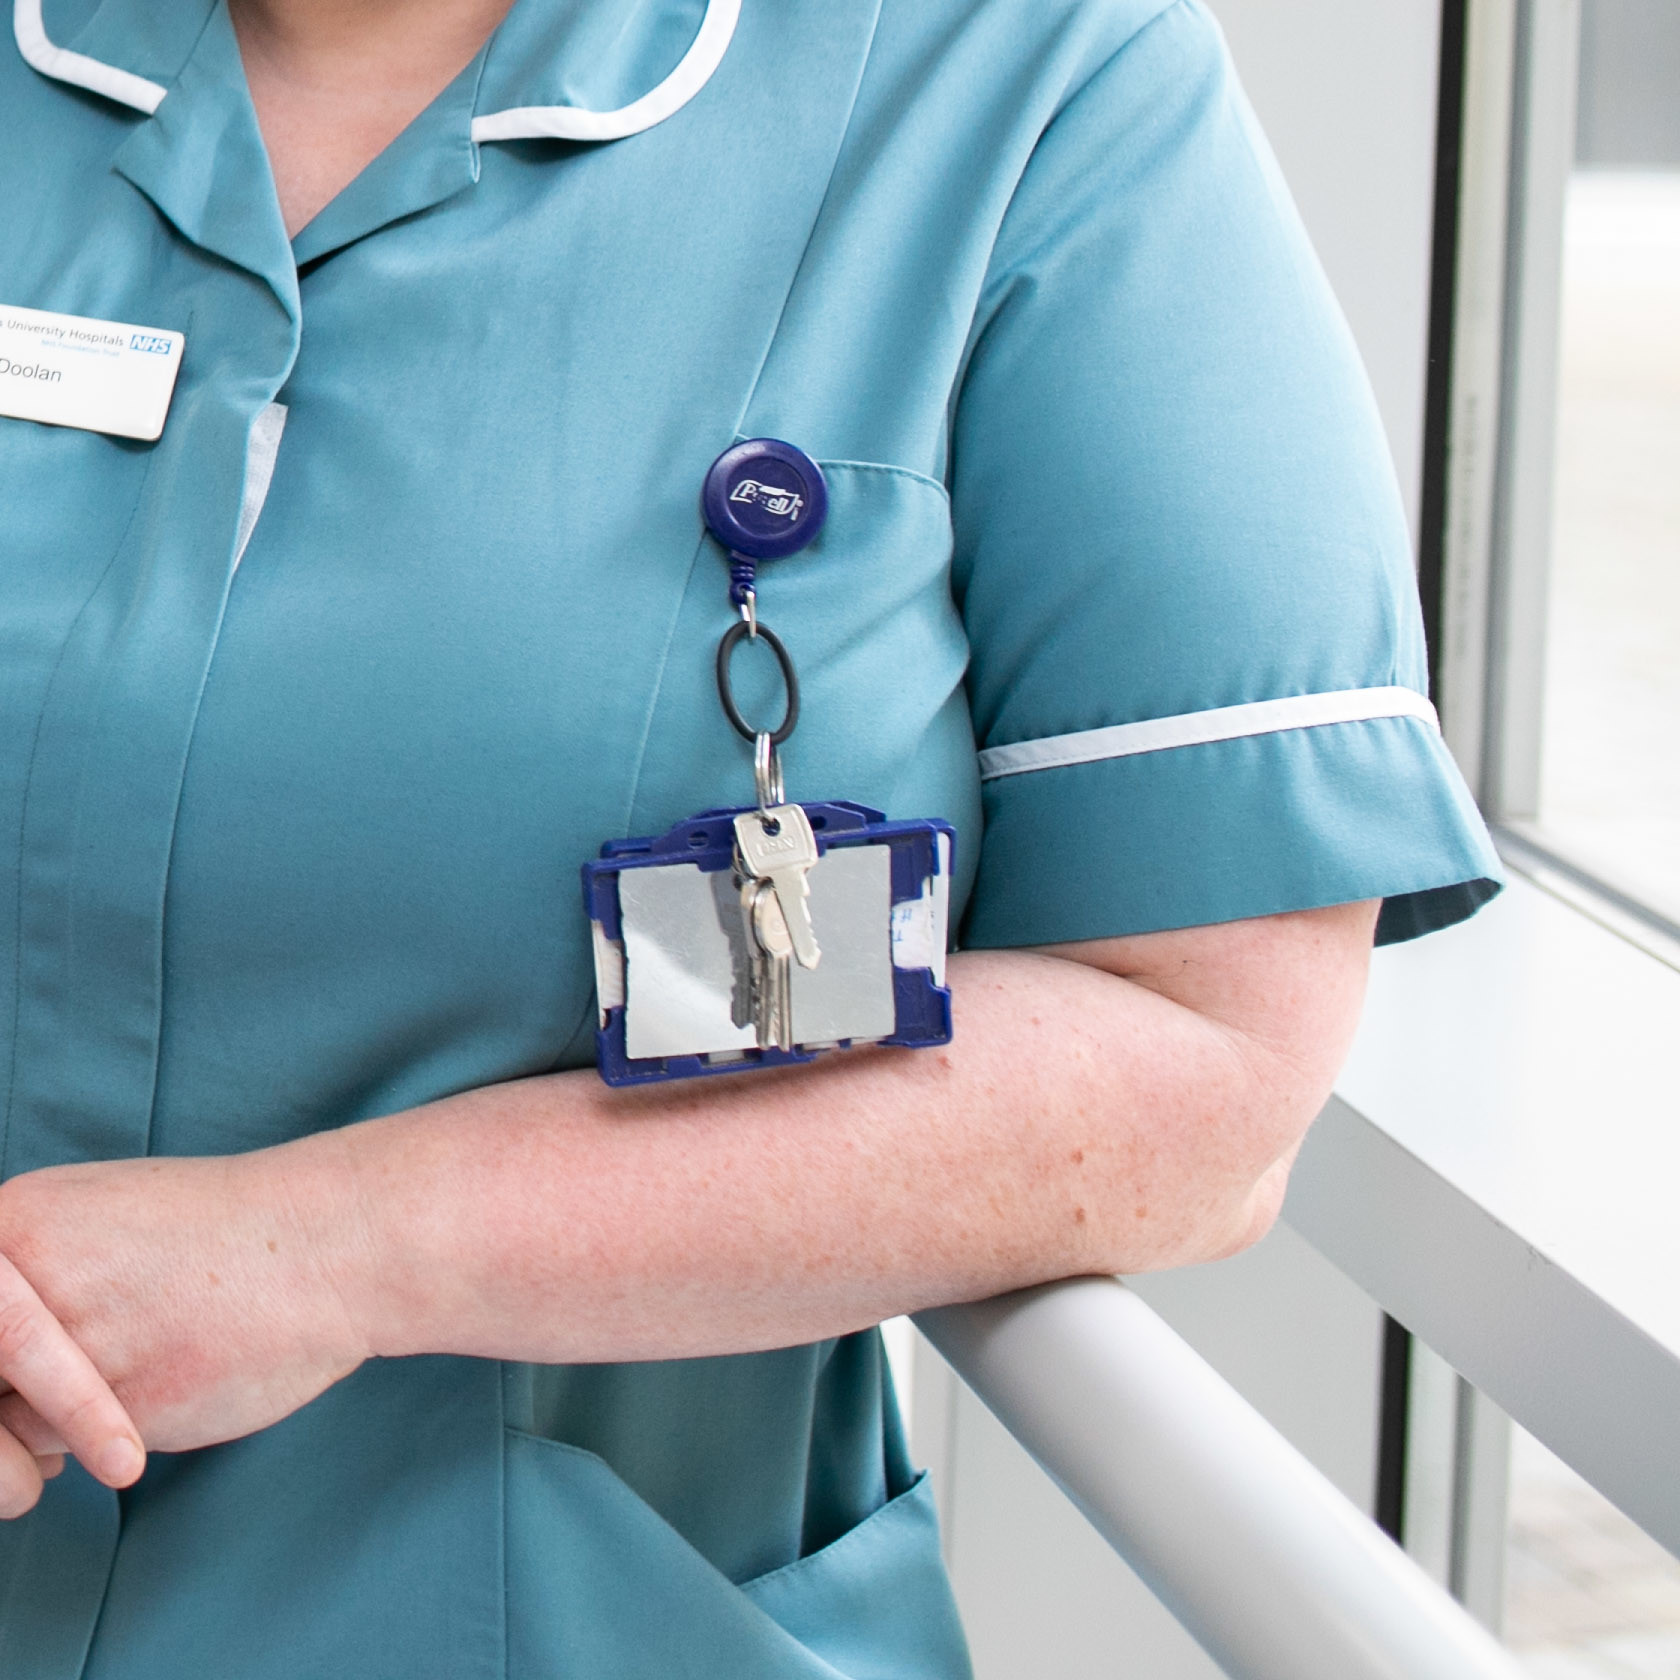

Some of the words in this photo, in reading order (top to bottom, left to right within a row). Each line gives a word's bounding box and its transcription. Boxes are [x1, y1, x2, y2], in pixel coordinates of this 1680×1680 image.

[7, 320, 67, 338] University
[69, 329, 125, 347] Hospitals
[130, 334, 172, 355] NHS
[739, 483, 789, 512] Pell
